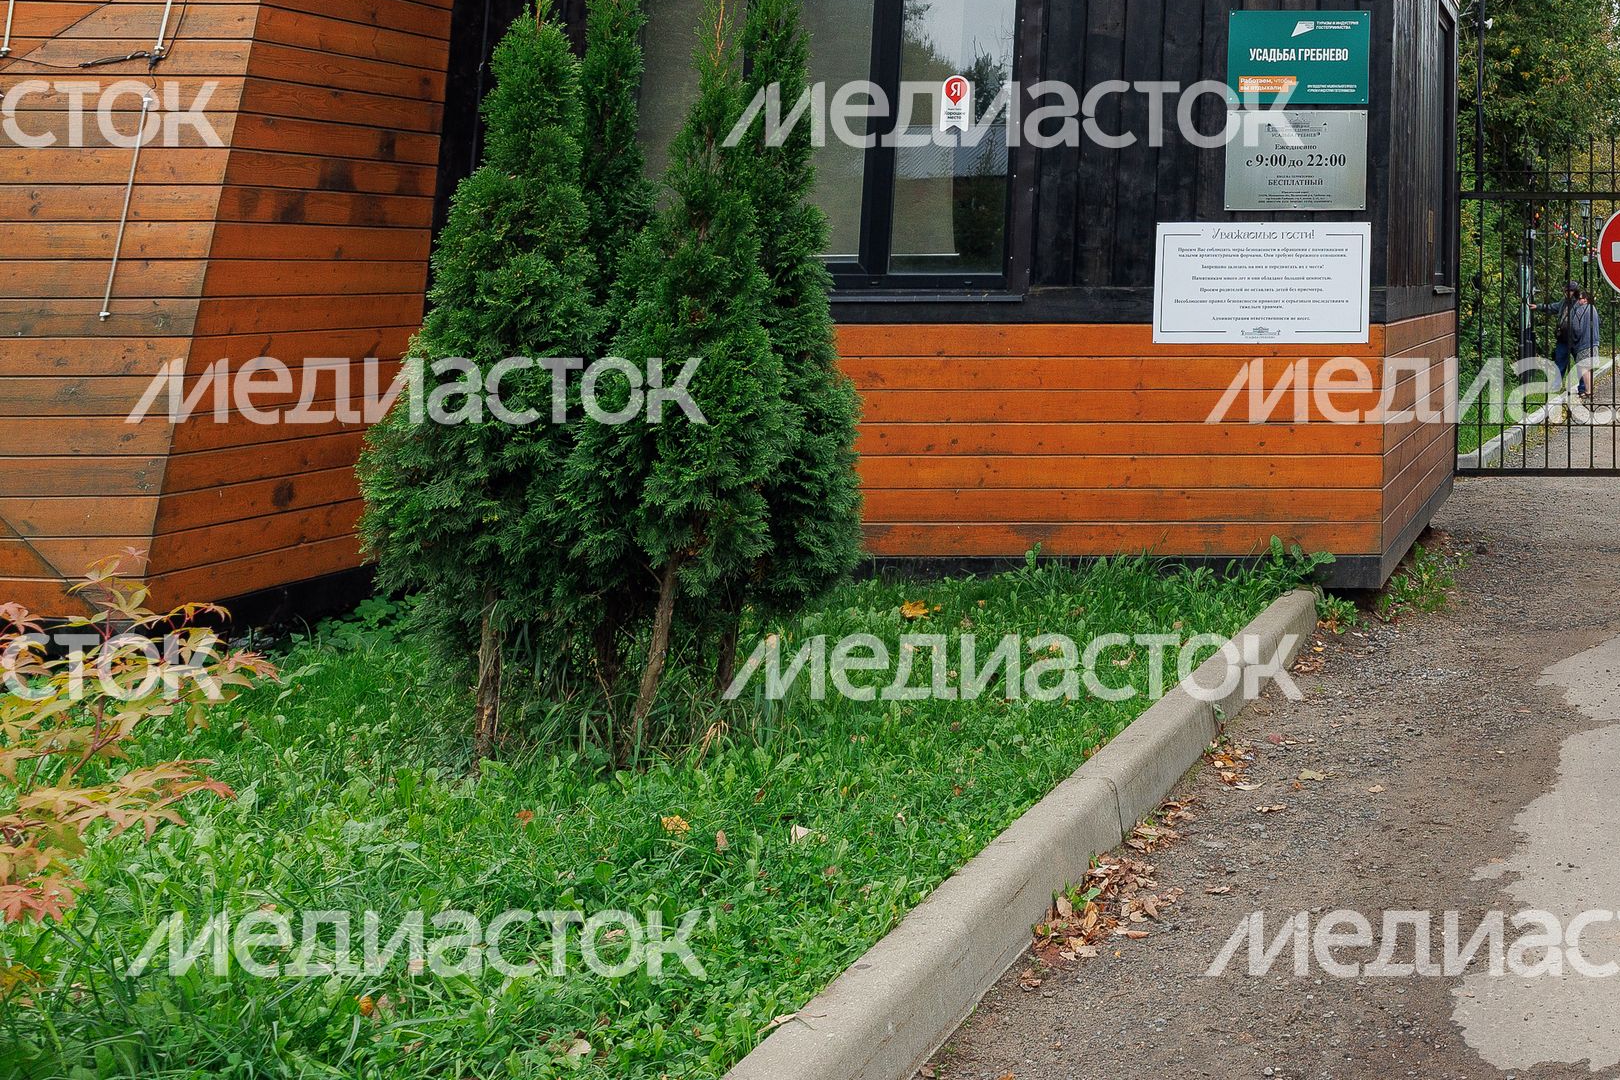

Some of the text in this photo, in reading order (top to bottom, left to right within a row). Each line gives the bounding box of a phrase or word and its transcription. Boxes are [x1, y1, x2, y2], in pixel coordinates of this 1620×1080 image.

[1249, 48, 1349, 62] УСАДЬБА ГРЕБНЕВО
[1275, 143, 1317, 151] Ежедневно
[1246, 154, 1346, 168] с 9:00 до 22:00
[1268, 178, 1323, 186] БЕСПЛАТНЫЙ
[1212, 227, 1315, 240] Уважаемые гости!
